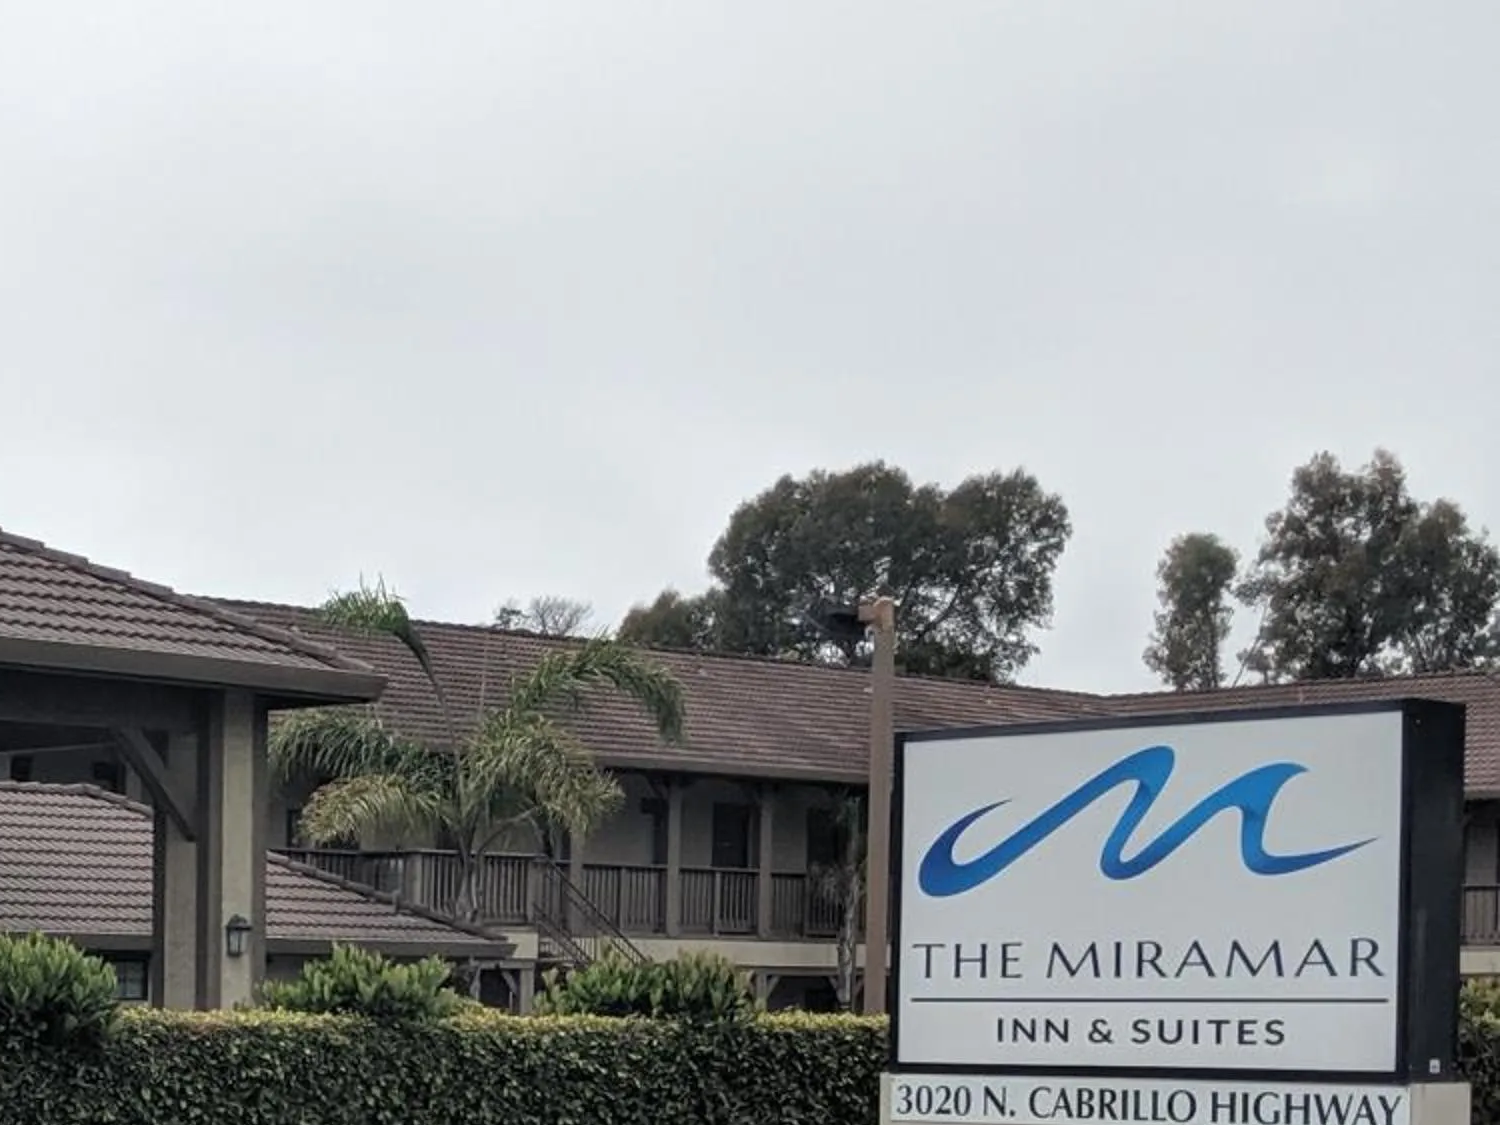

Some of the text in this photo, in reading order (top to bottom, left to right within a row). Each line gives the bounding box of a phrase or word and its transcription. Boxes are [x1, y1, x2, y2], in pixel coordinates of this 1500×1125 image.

[912, 938, 1385, 978] THE MIRAMAR
[997, 1018, 1286, 1046] INN & SUITES
[897, 1084, 971, 1117] 3020
[983, 1087, 1016, 1118] N.
[1028, 1089, 1197, 1123] CABRILLO
